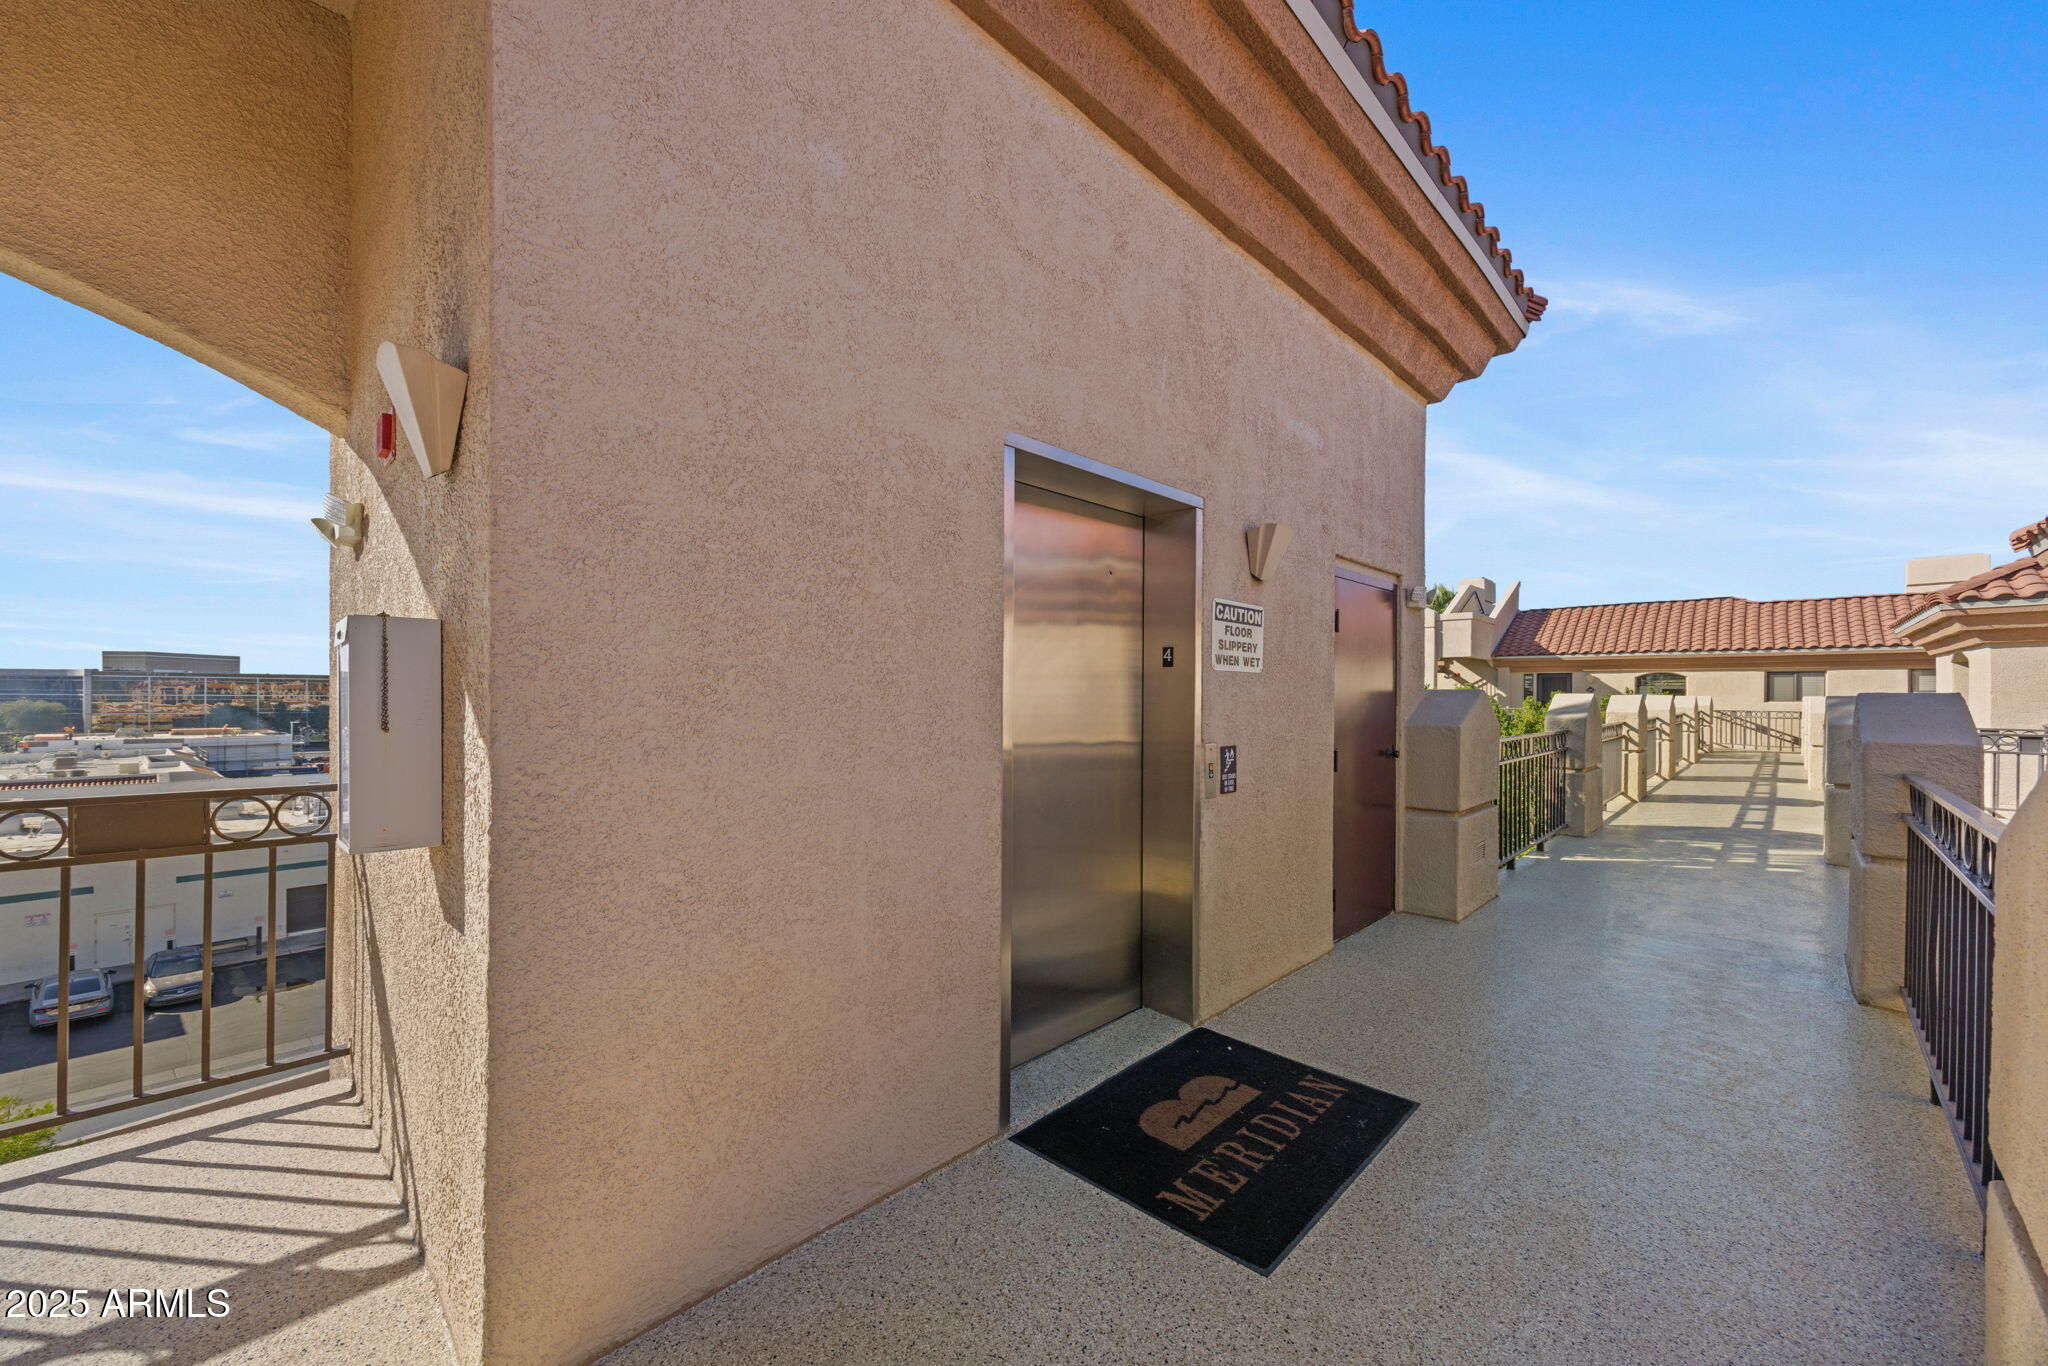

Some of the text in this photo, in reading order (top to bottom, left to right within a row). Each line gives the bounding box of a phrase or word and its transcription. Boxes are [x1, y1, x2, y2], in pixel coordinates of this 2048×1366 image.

[1215, 604, 1262, 625] CAUTION
[1225, 625, 1252, 638] FLOOR
[1218, 639, 1257, 653] SLIPPERY
[1163, 648, 1173, 662] 4
[1215, 654, 1261, 668] WHEN WET
[1156, 1074, 1349, 1221] MERIDIAN
